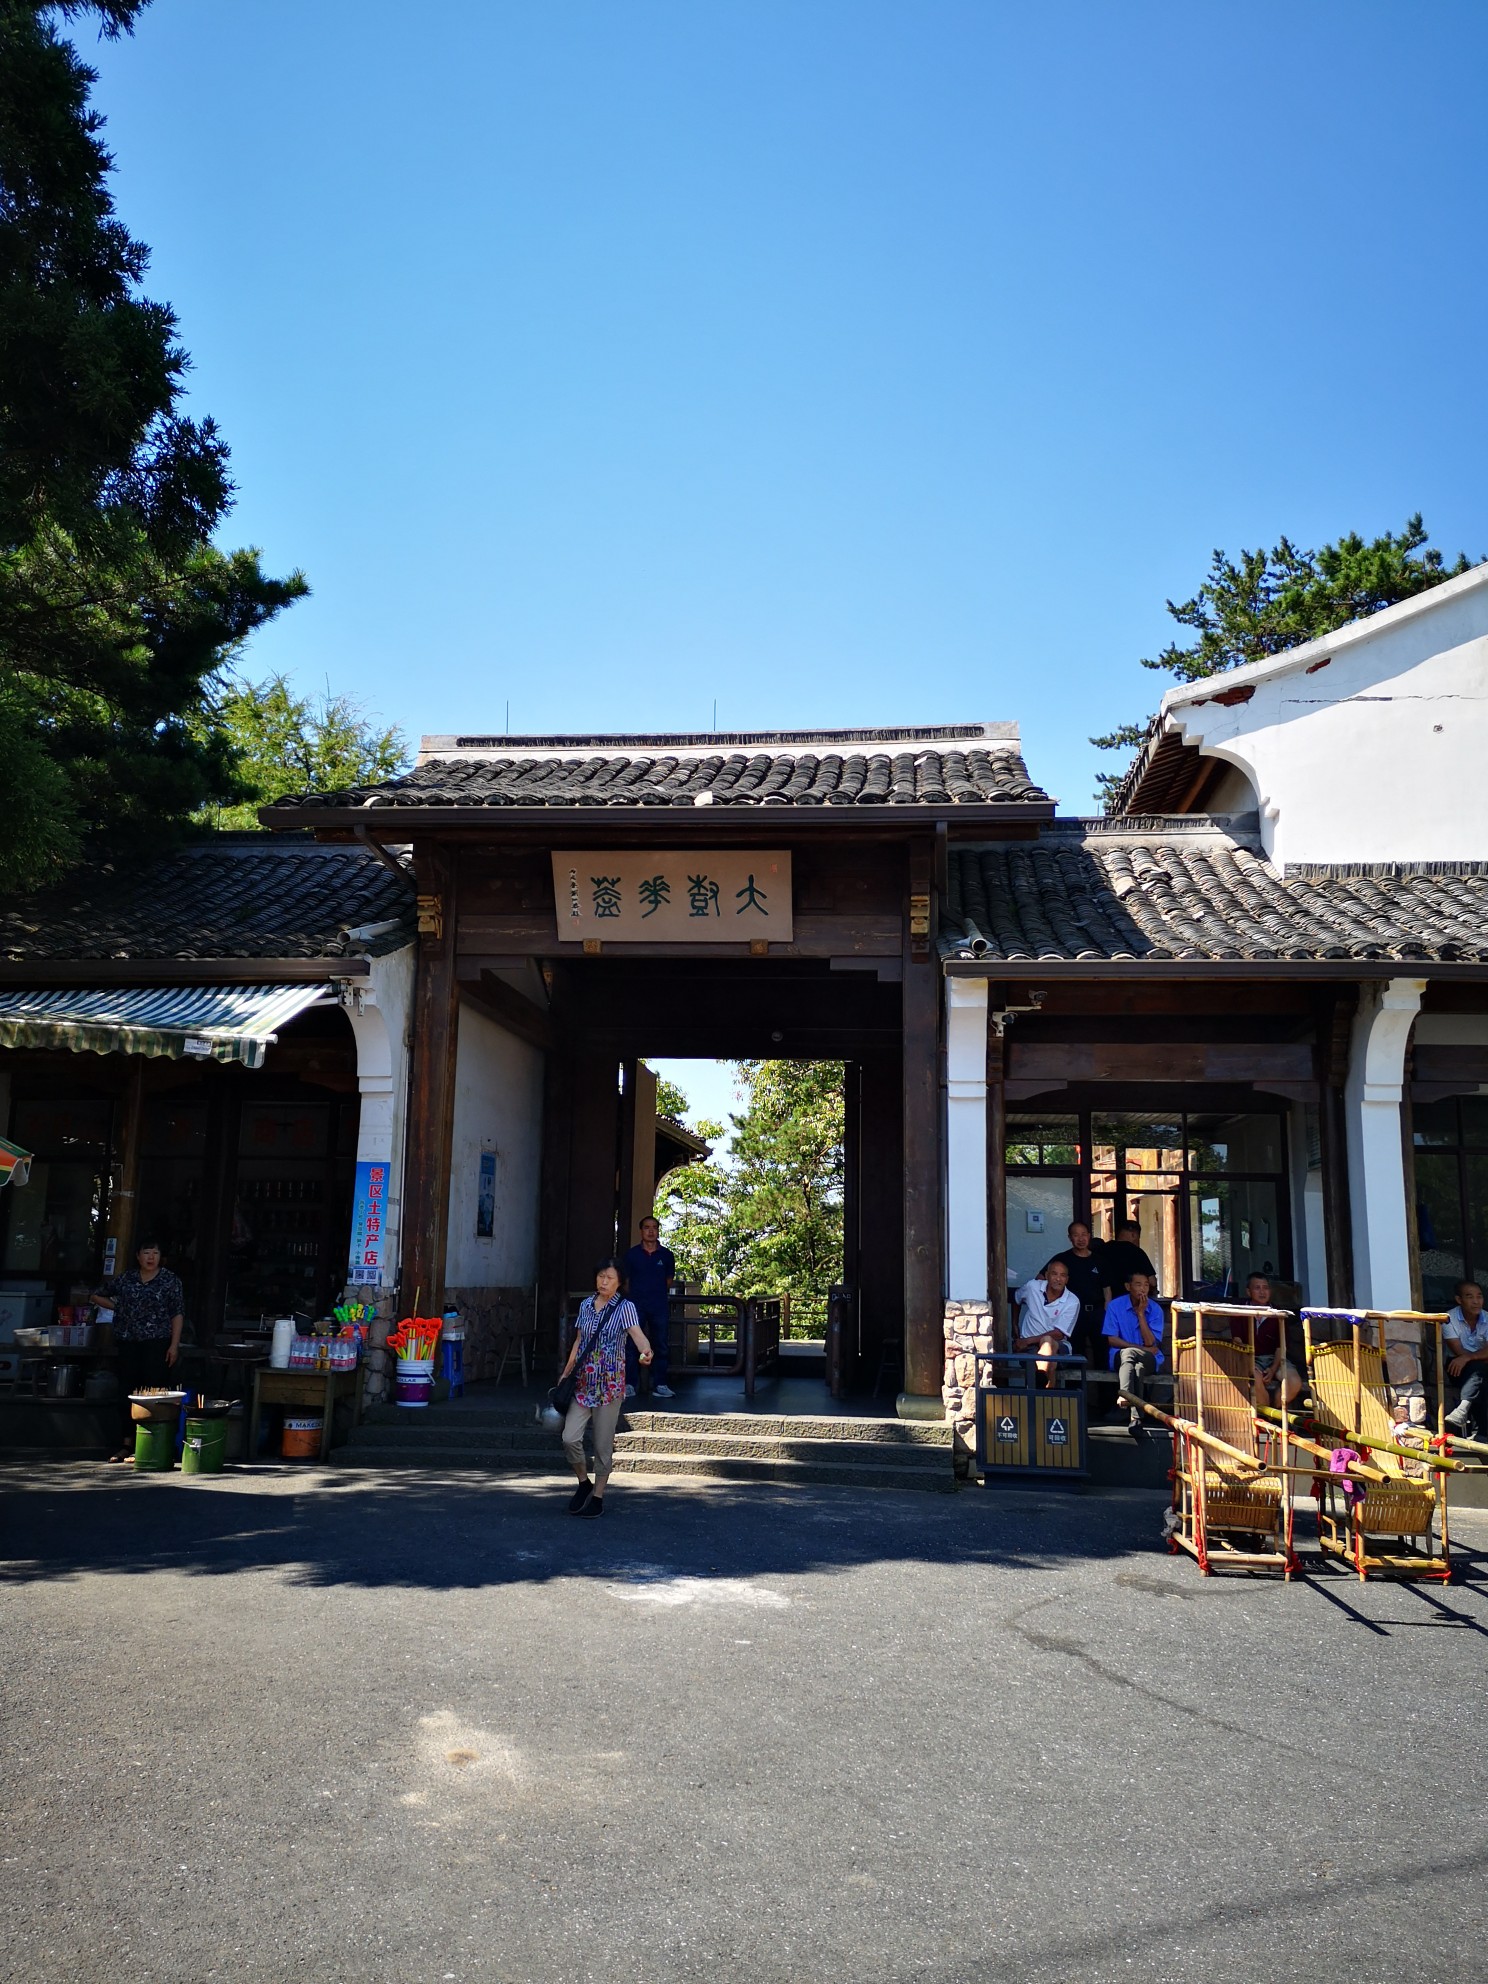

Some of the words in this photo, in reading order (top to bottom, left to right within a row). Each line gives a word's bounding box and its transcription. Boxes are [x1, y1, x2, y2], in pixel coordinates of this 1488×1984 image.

[364, 1168, 385, 1265] 景区土特产店
